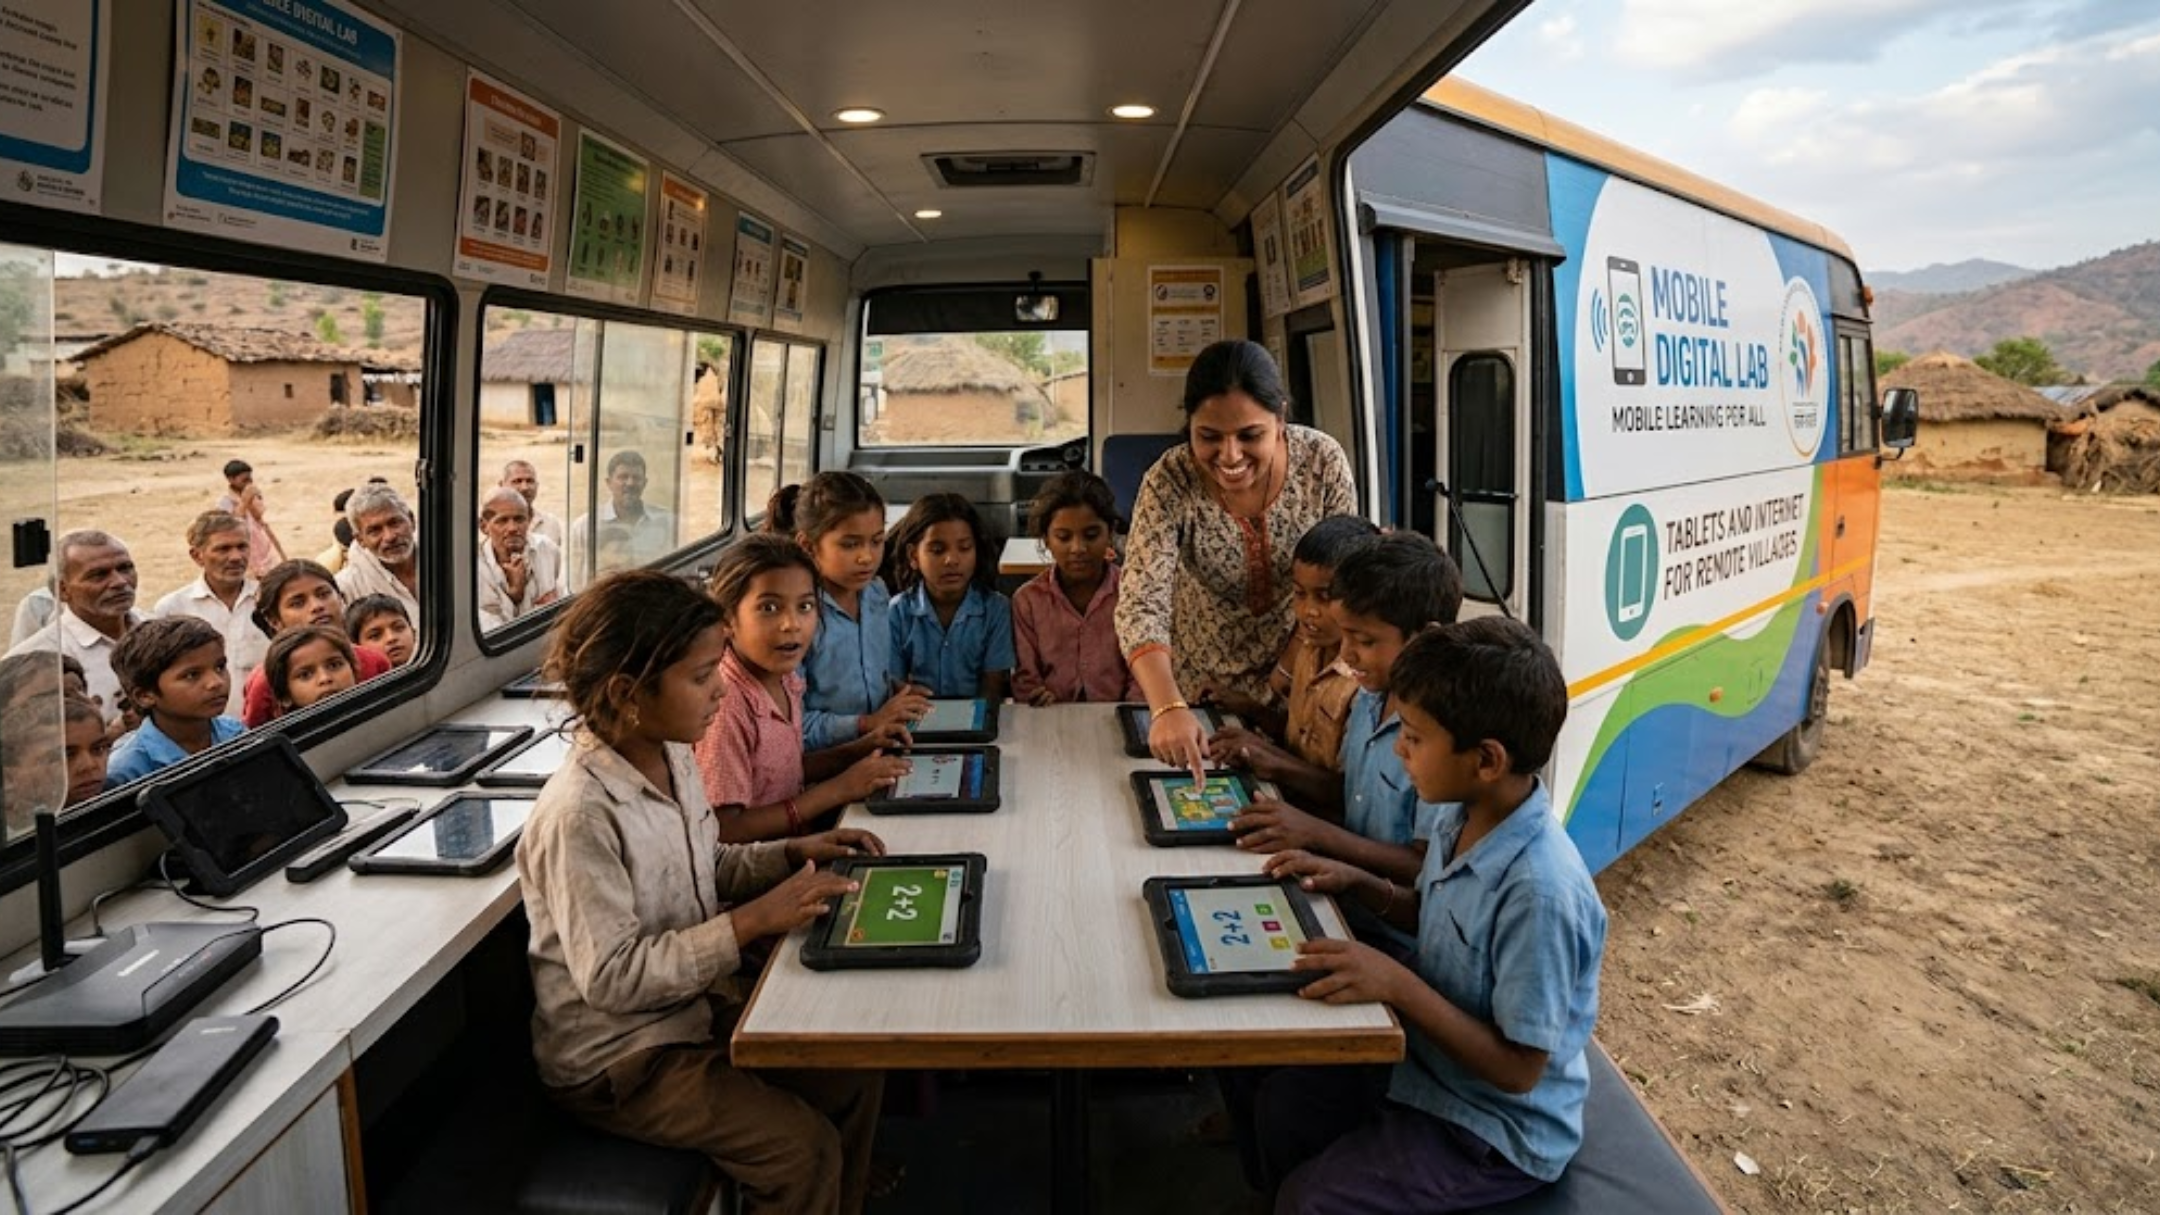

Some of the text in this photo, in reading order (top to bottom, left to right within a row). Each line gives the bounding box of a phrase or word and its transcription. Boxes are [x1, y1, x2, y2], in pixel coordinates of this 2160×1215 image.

[337, 23, 358, 46] LAB
[1651, 265, 1729, 328] MOBILE
[1655, 333, 1769, 390] DIGITAL LAB
[1612, 406, 1663, 433] MOBILE
[1666, 405, 1723, 430] LEARNING
[1748, 405, 1767, 427] ALL
[1666, 493, 1804, 554] TABLETS AND INTERNET
[1664, 561, 1692, 601] FOR
[886, 884, 923, 921] 2+2
[1212, 910, 1251, 946] 2+2
